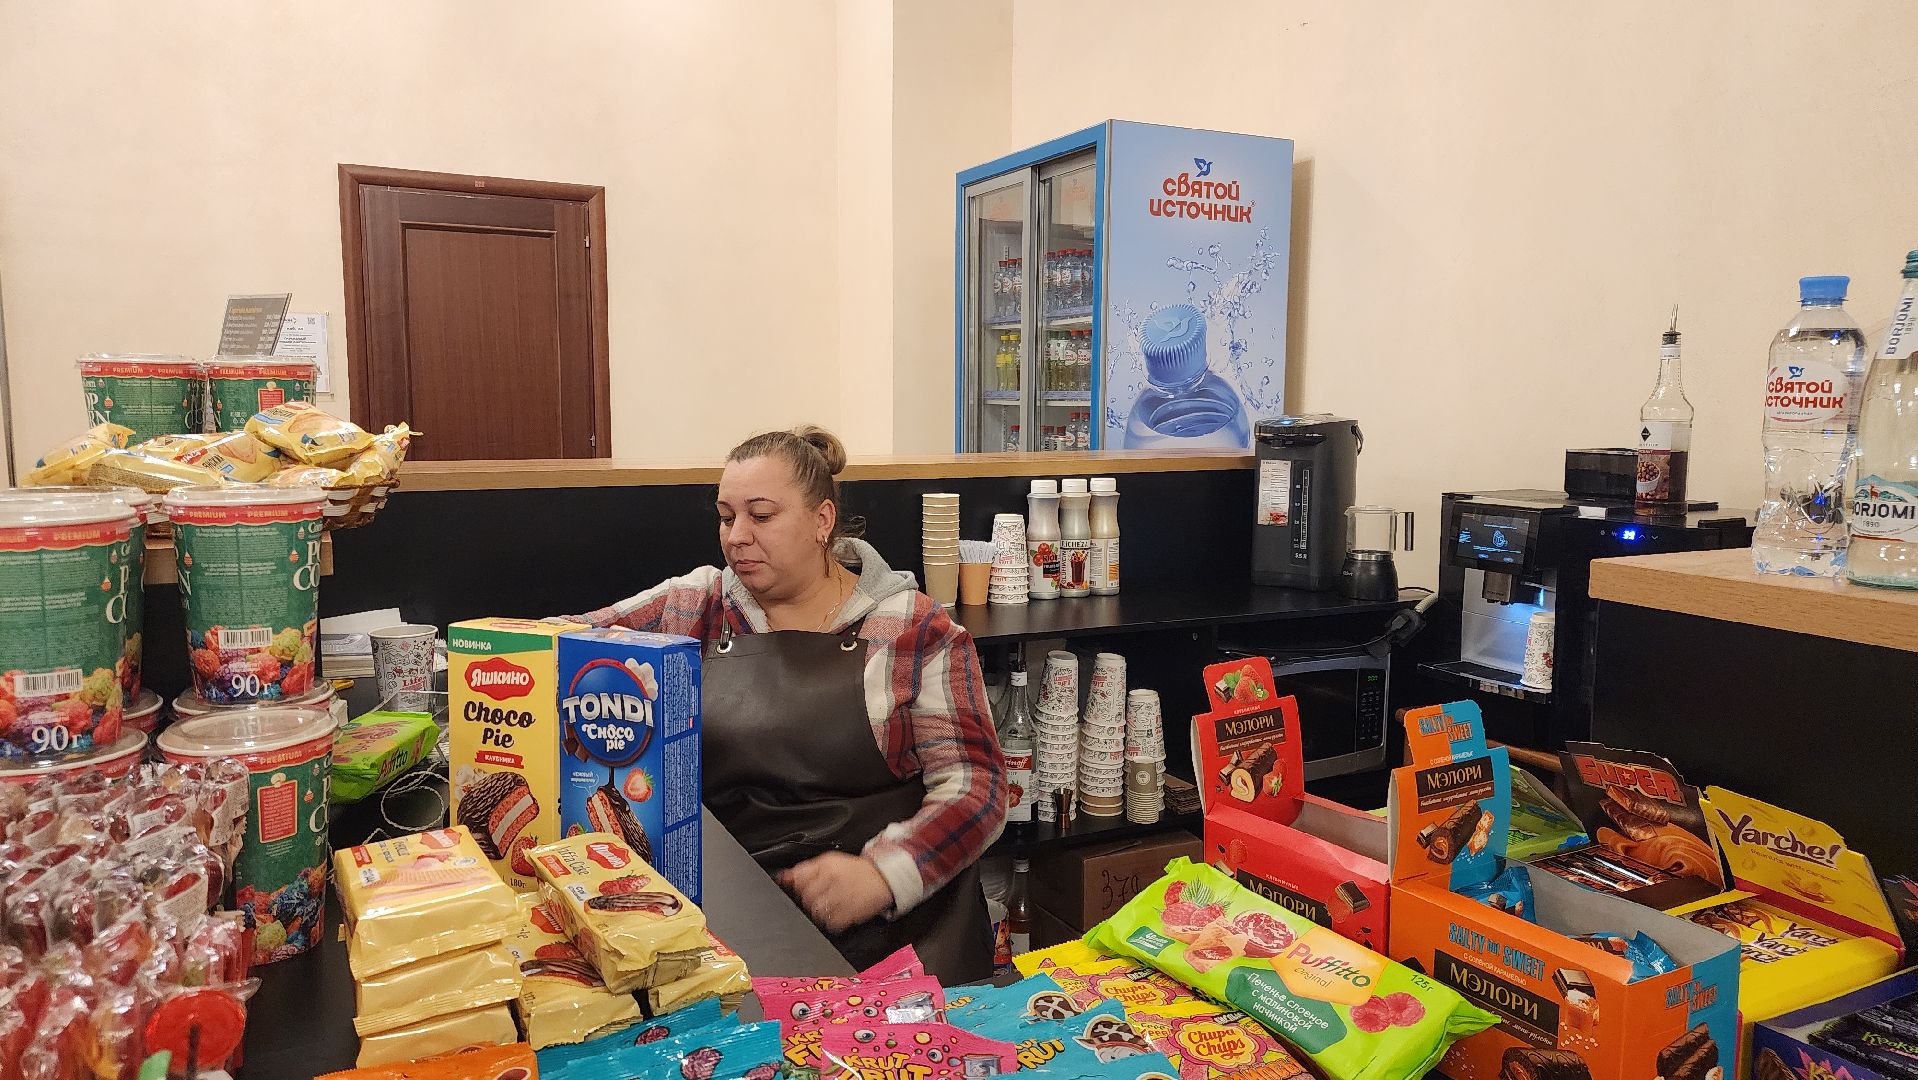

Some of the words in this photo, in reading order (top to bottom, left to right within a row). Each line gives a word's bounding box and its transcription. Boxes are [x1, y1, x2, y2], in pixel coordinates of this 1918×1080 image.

[1885, 297, 1914, 354] BORJOMI
[112, 366, 144, 374] PREMIUM
[190, 511, 227, 519] PREMIUM
[247, 510, 289, 518] PREMIUM
[53, 530, 100, 541] PREMIUM
[452, 638, 492, 651] НОВИНКА
[464, 701, 537, 728] Choco
[563, 692, 654, 727] TONDI
[481, 727, 514, 748] Pie
[1225, 714, 1275, 737] МЭЛОРИ
[1447, 722, 1472, 741] SWEET
[606, 737, 625, 752] pie
[260, 751, 303, 765] PREMIUM
[1427, 764, 1483, 790] МЭЛОРИ
[1575, 756, 1684, 805] SUPER
[1716, 808, 1841, 866] Yarche!
[1249, 879, 1316, 922] МЭЛОРИ
[1449, 921, 1486, 955] SALTY
[1286, 943, 1371, 988] Puffitto
[1503, 945, 1546, 981] SWEET
[1104, 984, 1148, 997] Chupa
[1115, 990, 1157, 1006] Chups
[1247, 973, 1287, 1002] Печенье
[1450, 962, 1538, 1020] МЭЛОРИ
[1252, 1001, 1298, 1034] начинкой
[1258, 994, 1313, 1031] малиновой
[1187, 1027, 1237, 1045] Chupa
[842, 1052, 910, 1070] KRUT
[1194, 1037, 1246, 1061] Chups
